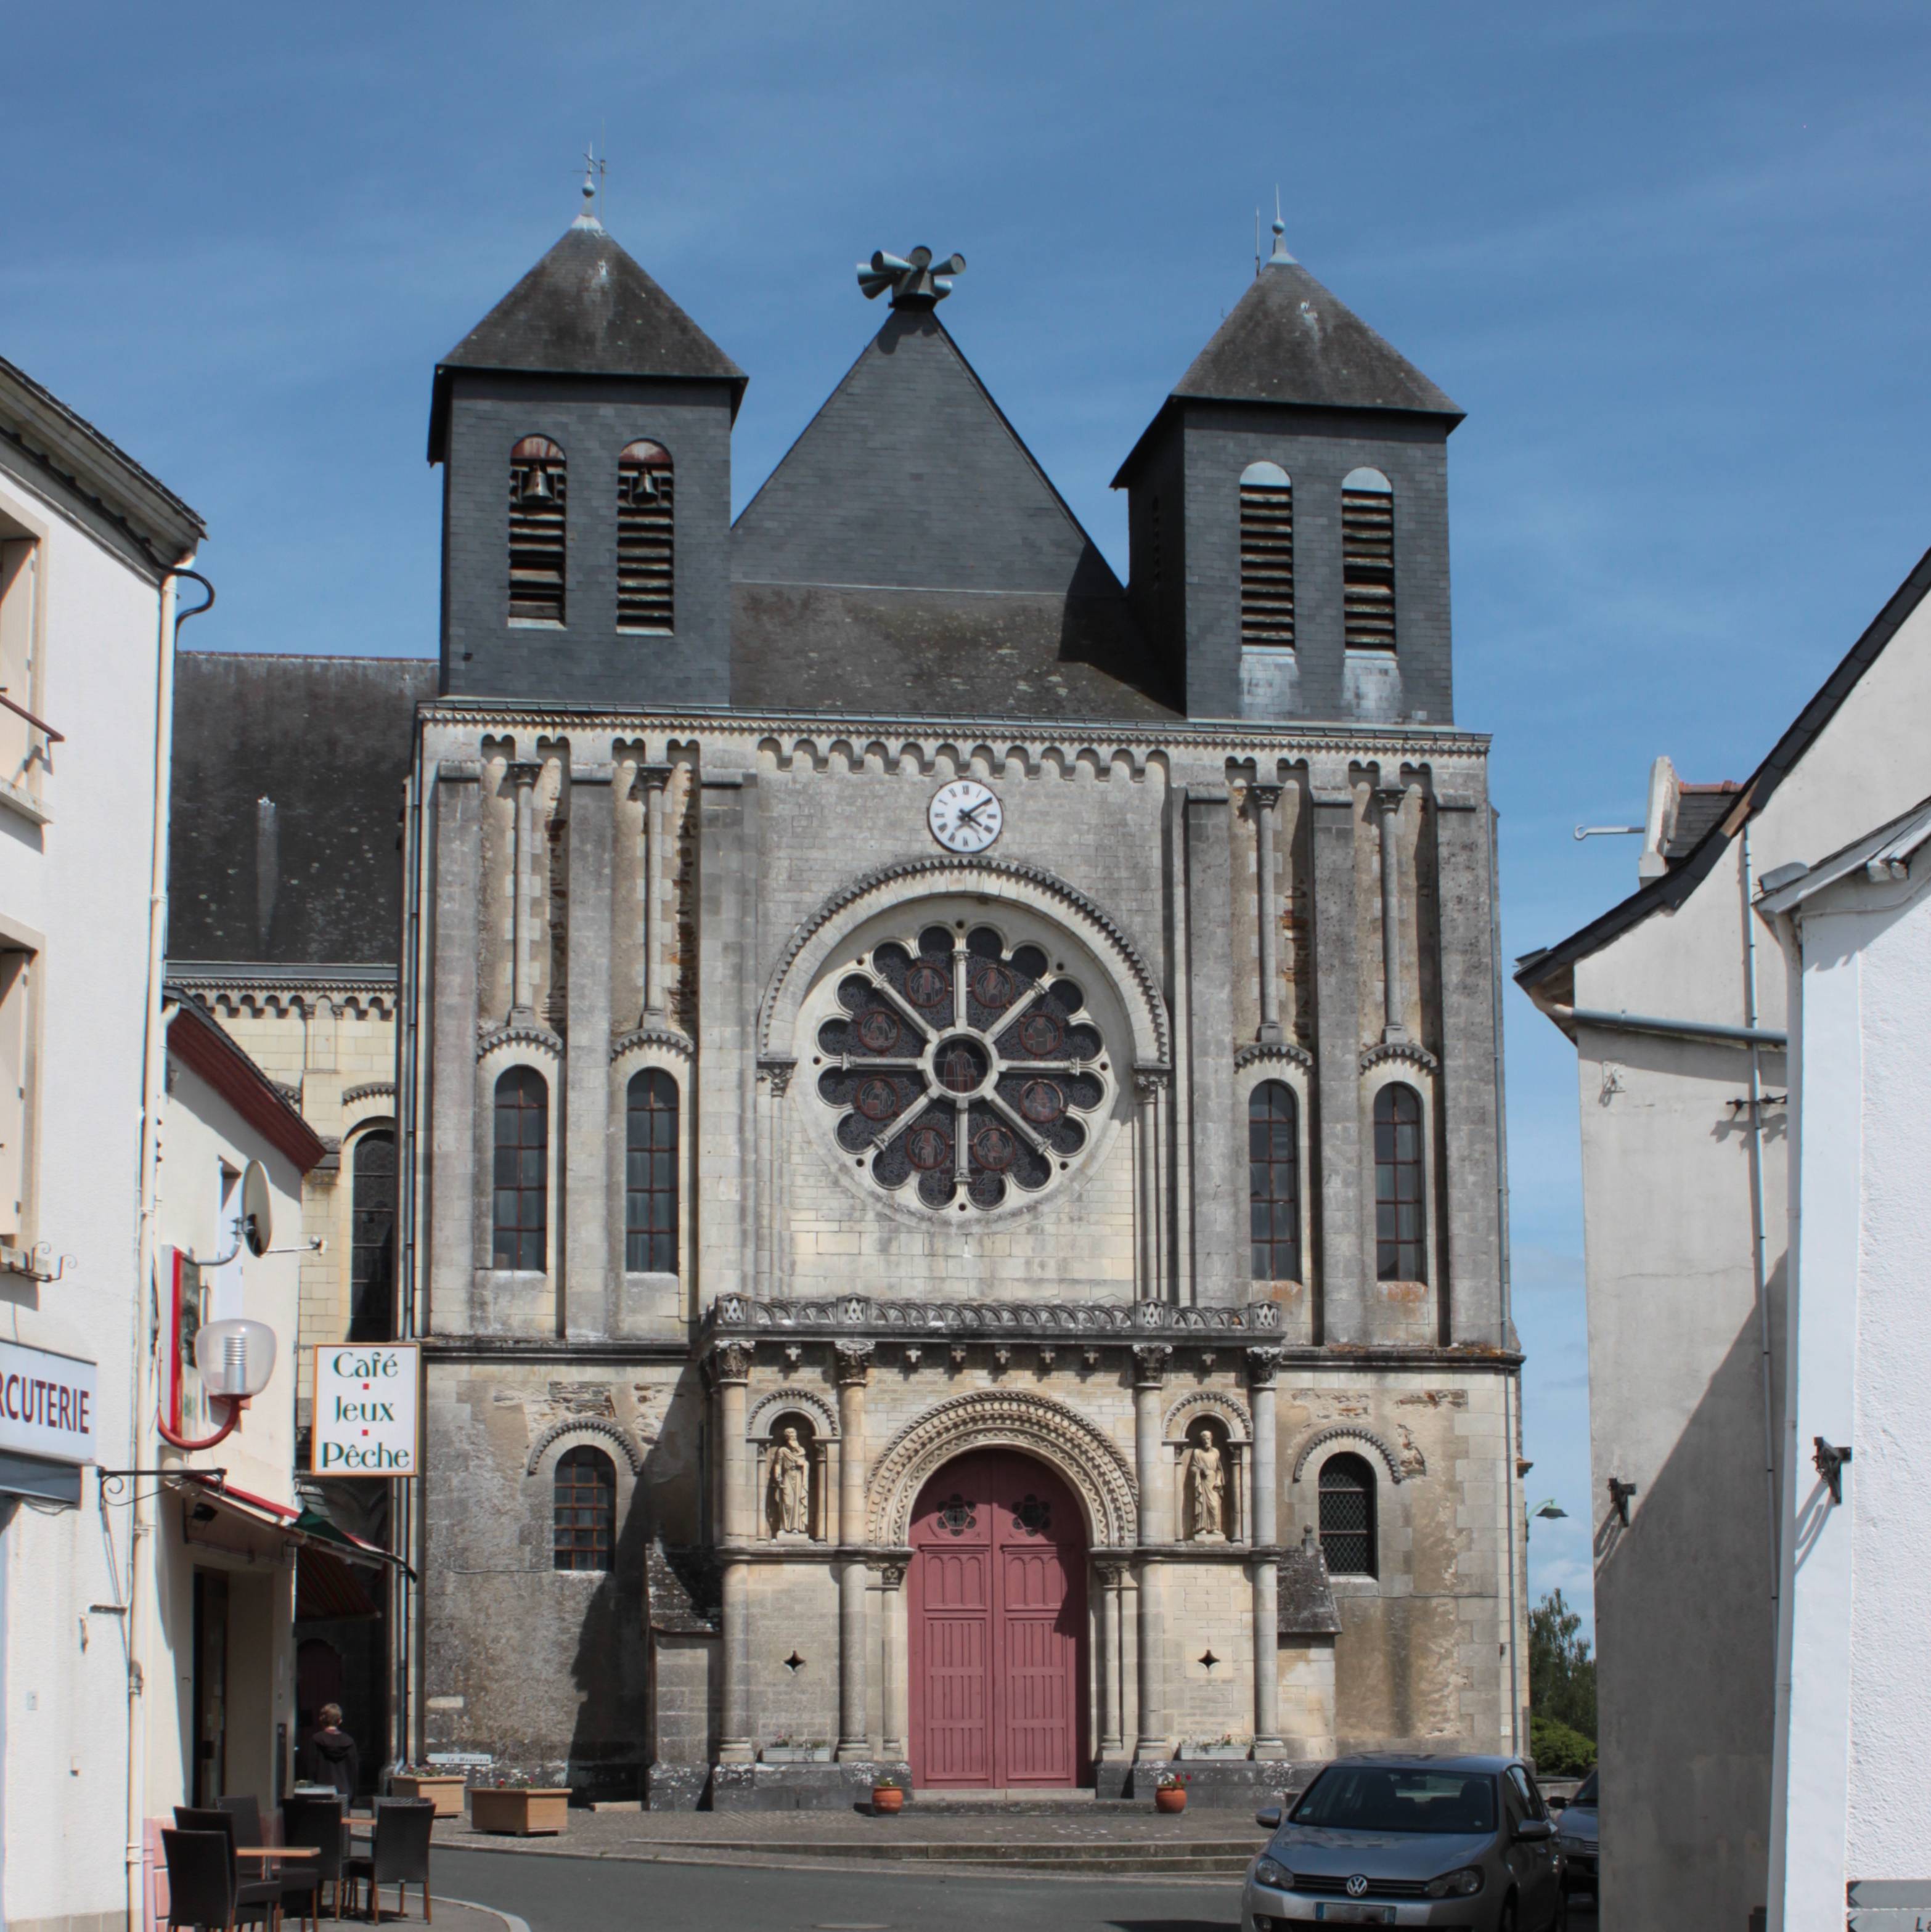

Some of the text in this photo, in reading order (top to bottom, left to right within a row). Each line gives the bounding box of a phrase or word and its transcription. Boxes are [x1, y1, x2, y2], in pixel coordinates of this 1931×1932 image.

[333, 1351, 398, 1377] Café
[335, 1396, 394, 1424] Jeux
[322, 1442, 409, 1468] Pêche
